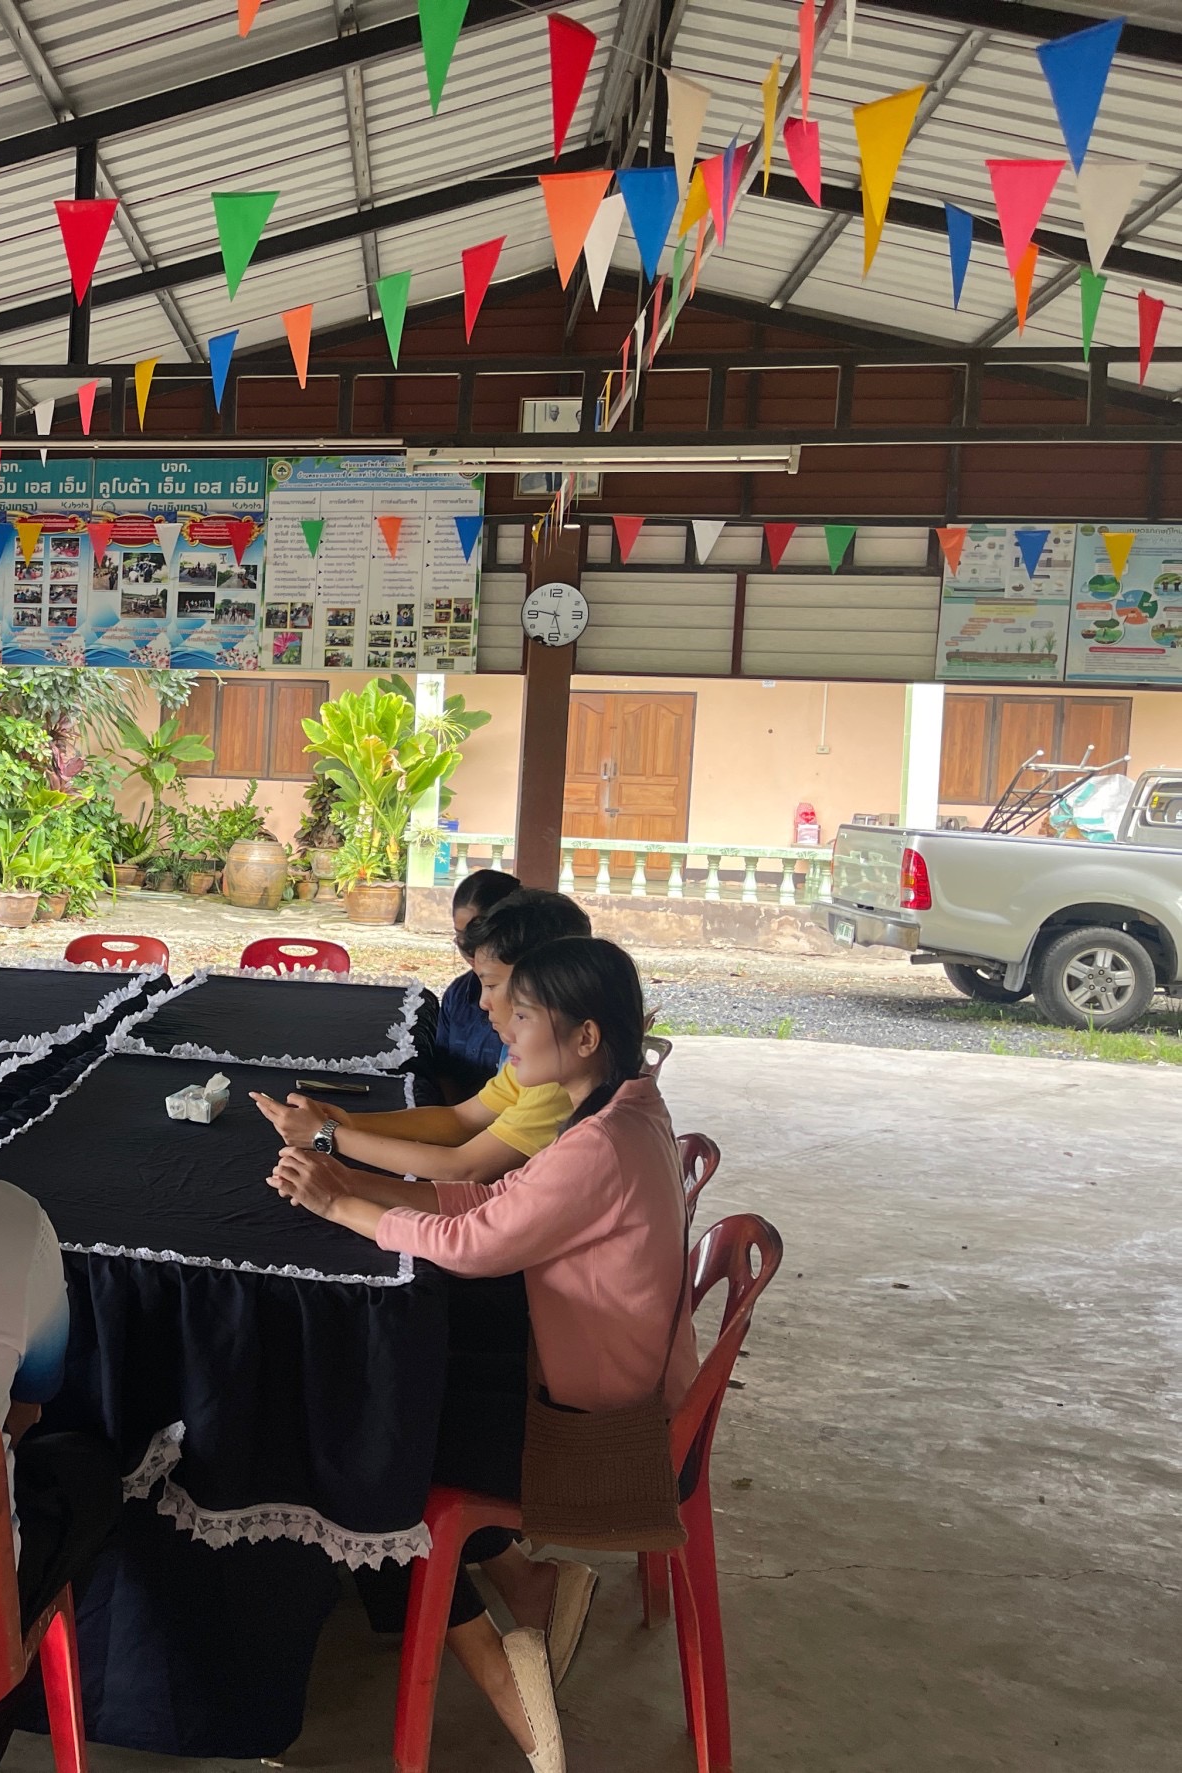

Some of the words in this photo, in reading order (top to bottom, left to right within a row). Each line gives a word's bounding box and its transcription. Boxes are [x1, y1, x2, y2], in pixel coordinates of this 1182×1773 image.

[161, 462, 191, 473] บจก.
[24, 481, 51, 494] เอส
[59, 476, 86, 494] เอ็ม
[99, 477, 149, 499] คูโบด้า
[157, 476, 185, 494] เอ็ม
[194, 481, 221, 494] เอส
[230, 476, 258, 494] เอ็ม
[550, 588, 563, 598] 12
[527, 610, 539, 619] 9
[571, 610, 583, 620] 3
[548, 632, 560, 642] 6
